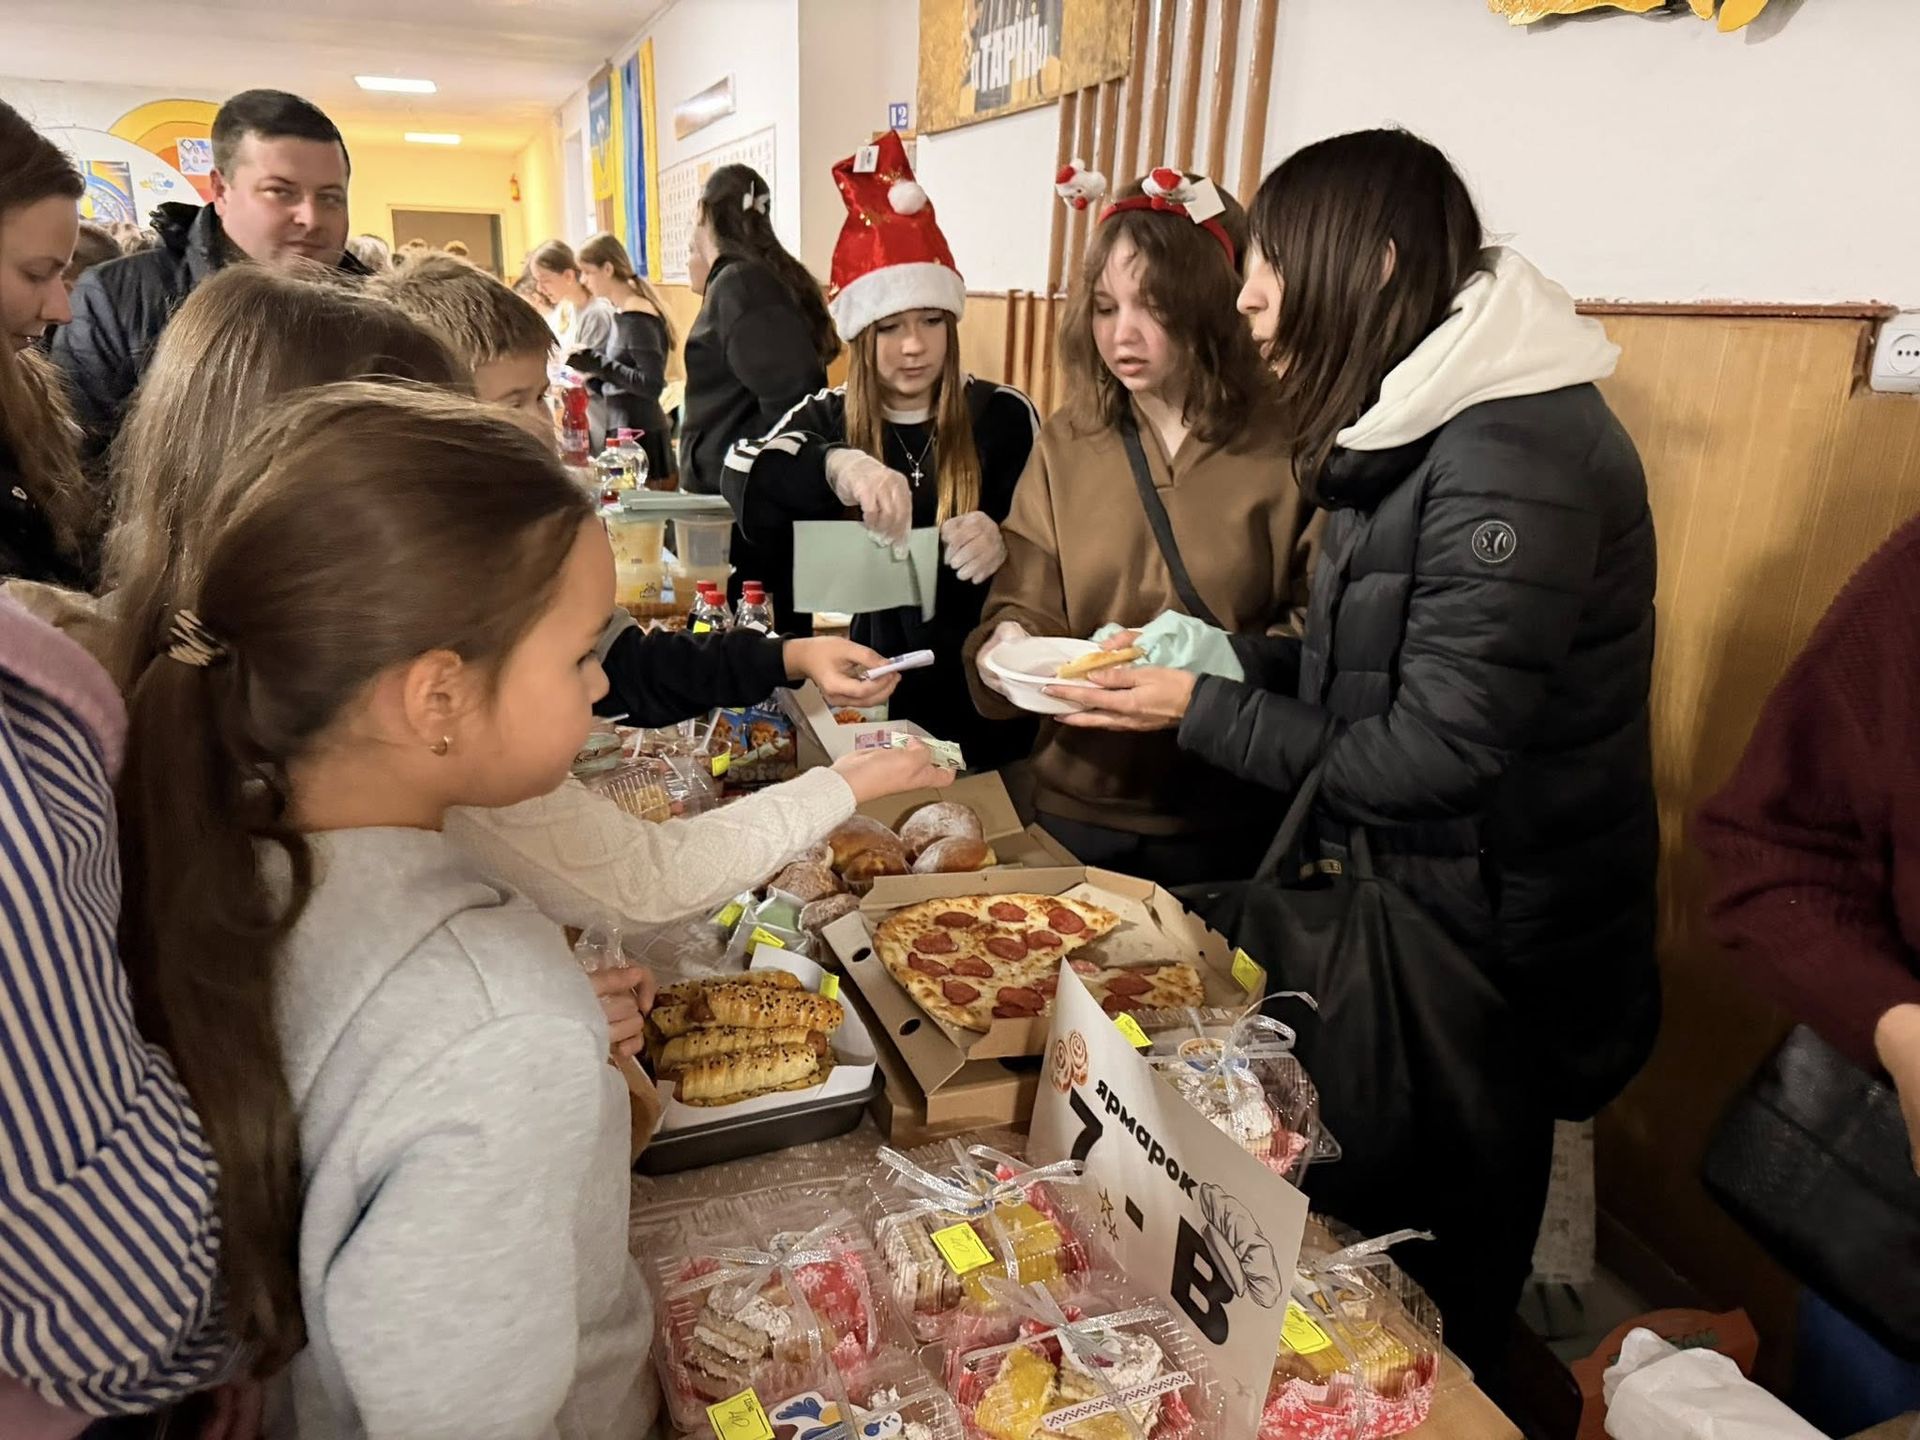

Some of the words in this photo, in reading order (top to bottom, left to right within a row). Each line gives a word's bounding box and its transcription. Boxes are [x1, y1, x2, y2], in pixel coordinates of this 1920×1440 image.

[890, 106, 907, 127] 12
[1095, 1079, 1199, 1201] ярмарок
[728, 1410, 751, 1428] 40
